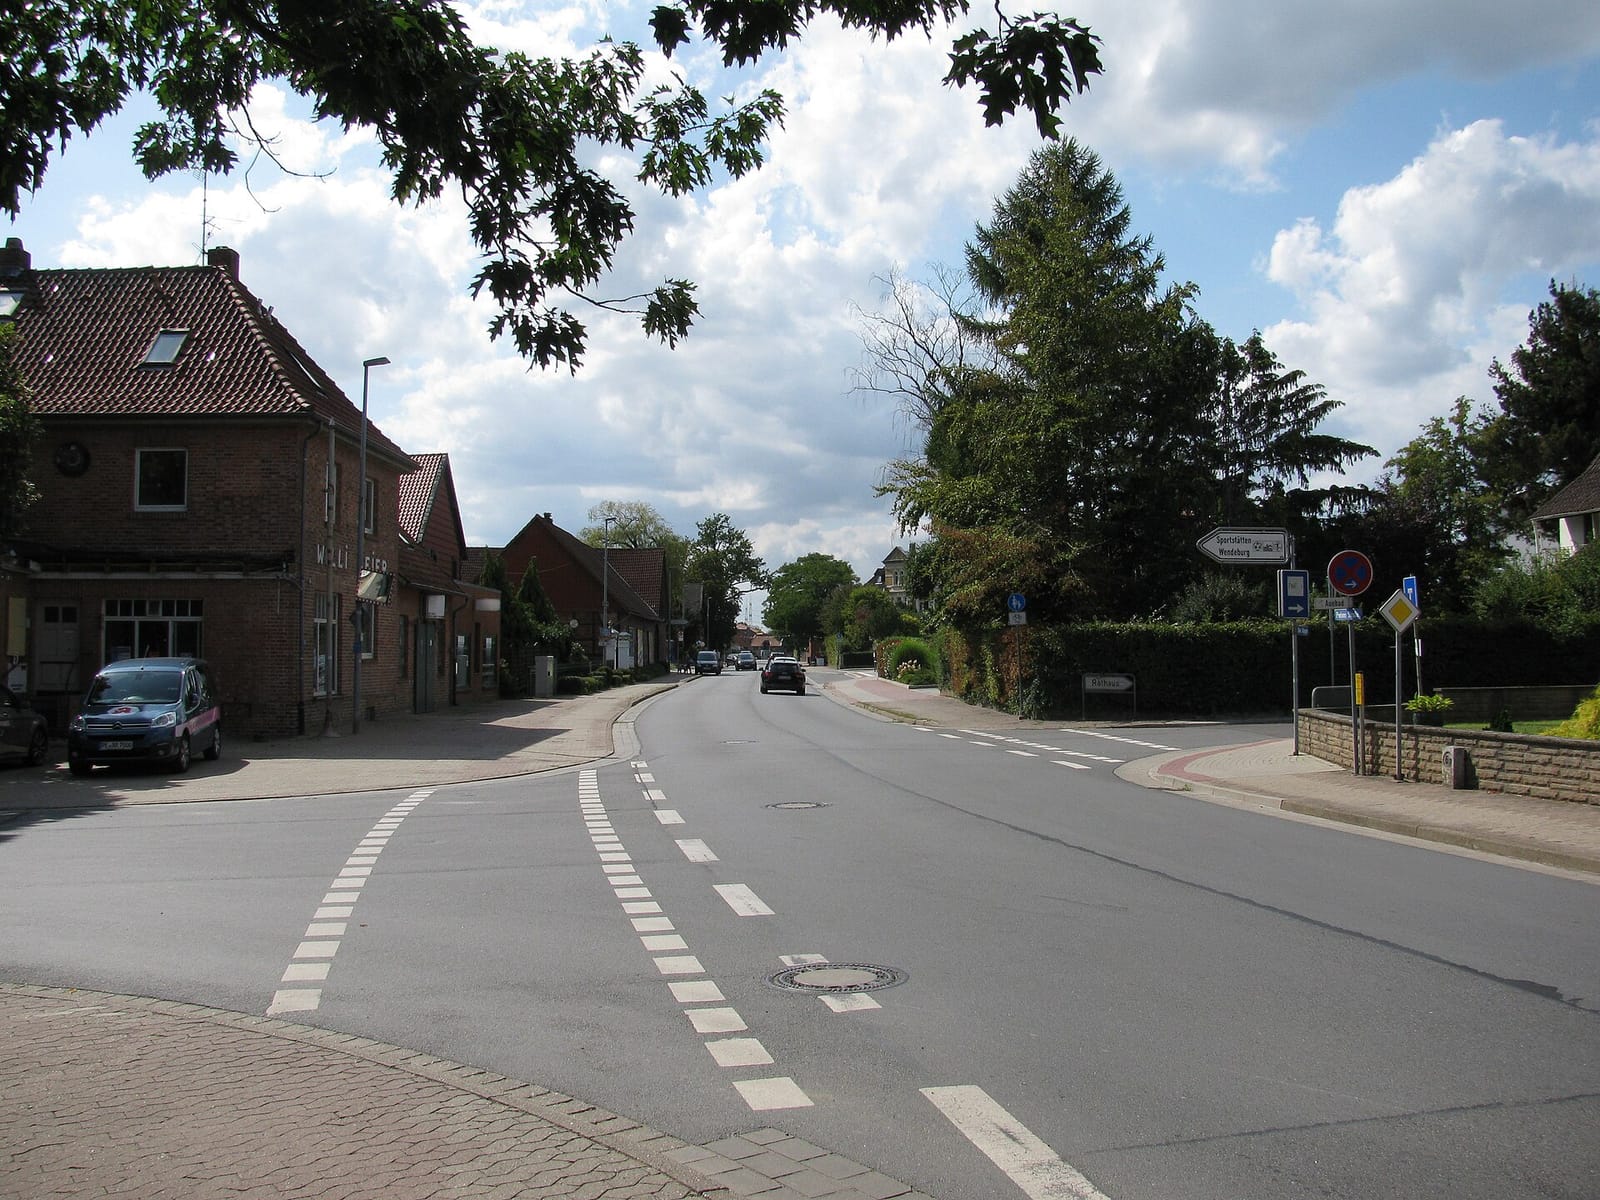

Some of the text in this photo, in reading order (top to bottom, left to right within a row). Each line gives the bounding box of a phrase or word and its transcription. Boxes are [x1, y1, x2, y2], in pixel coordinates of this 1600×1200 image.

[1216, 535, 1252, 545] Sportstätten
[1218, 547, 1250, 558] Wendeburg
[1091, 678, 1120, 687] Rathaus
